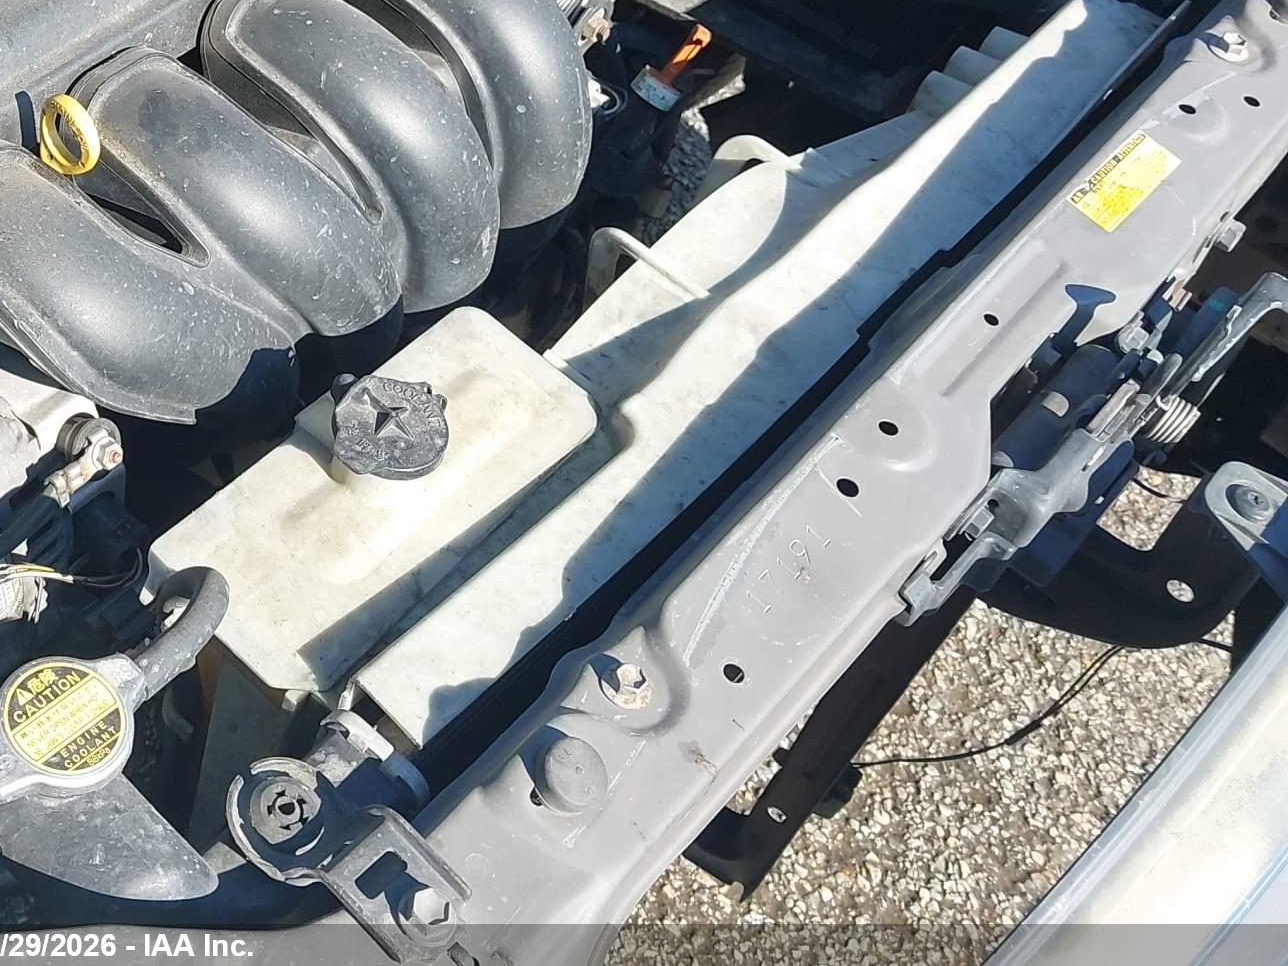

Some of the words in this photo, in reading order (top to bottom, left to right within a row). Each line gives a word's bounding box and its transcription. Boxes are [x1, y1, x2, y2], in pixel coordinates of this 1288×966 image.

[383, 382, 442, 427] COOLANT
[13, 671, 81, 723] CAUTION
[60, 720, 107, 758] ENGINE
[64, 726, 117, 768] COOLANT
